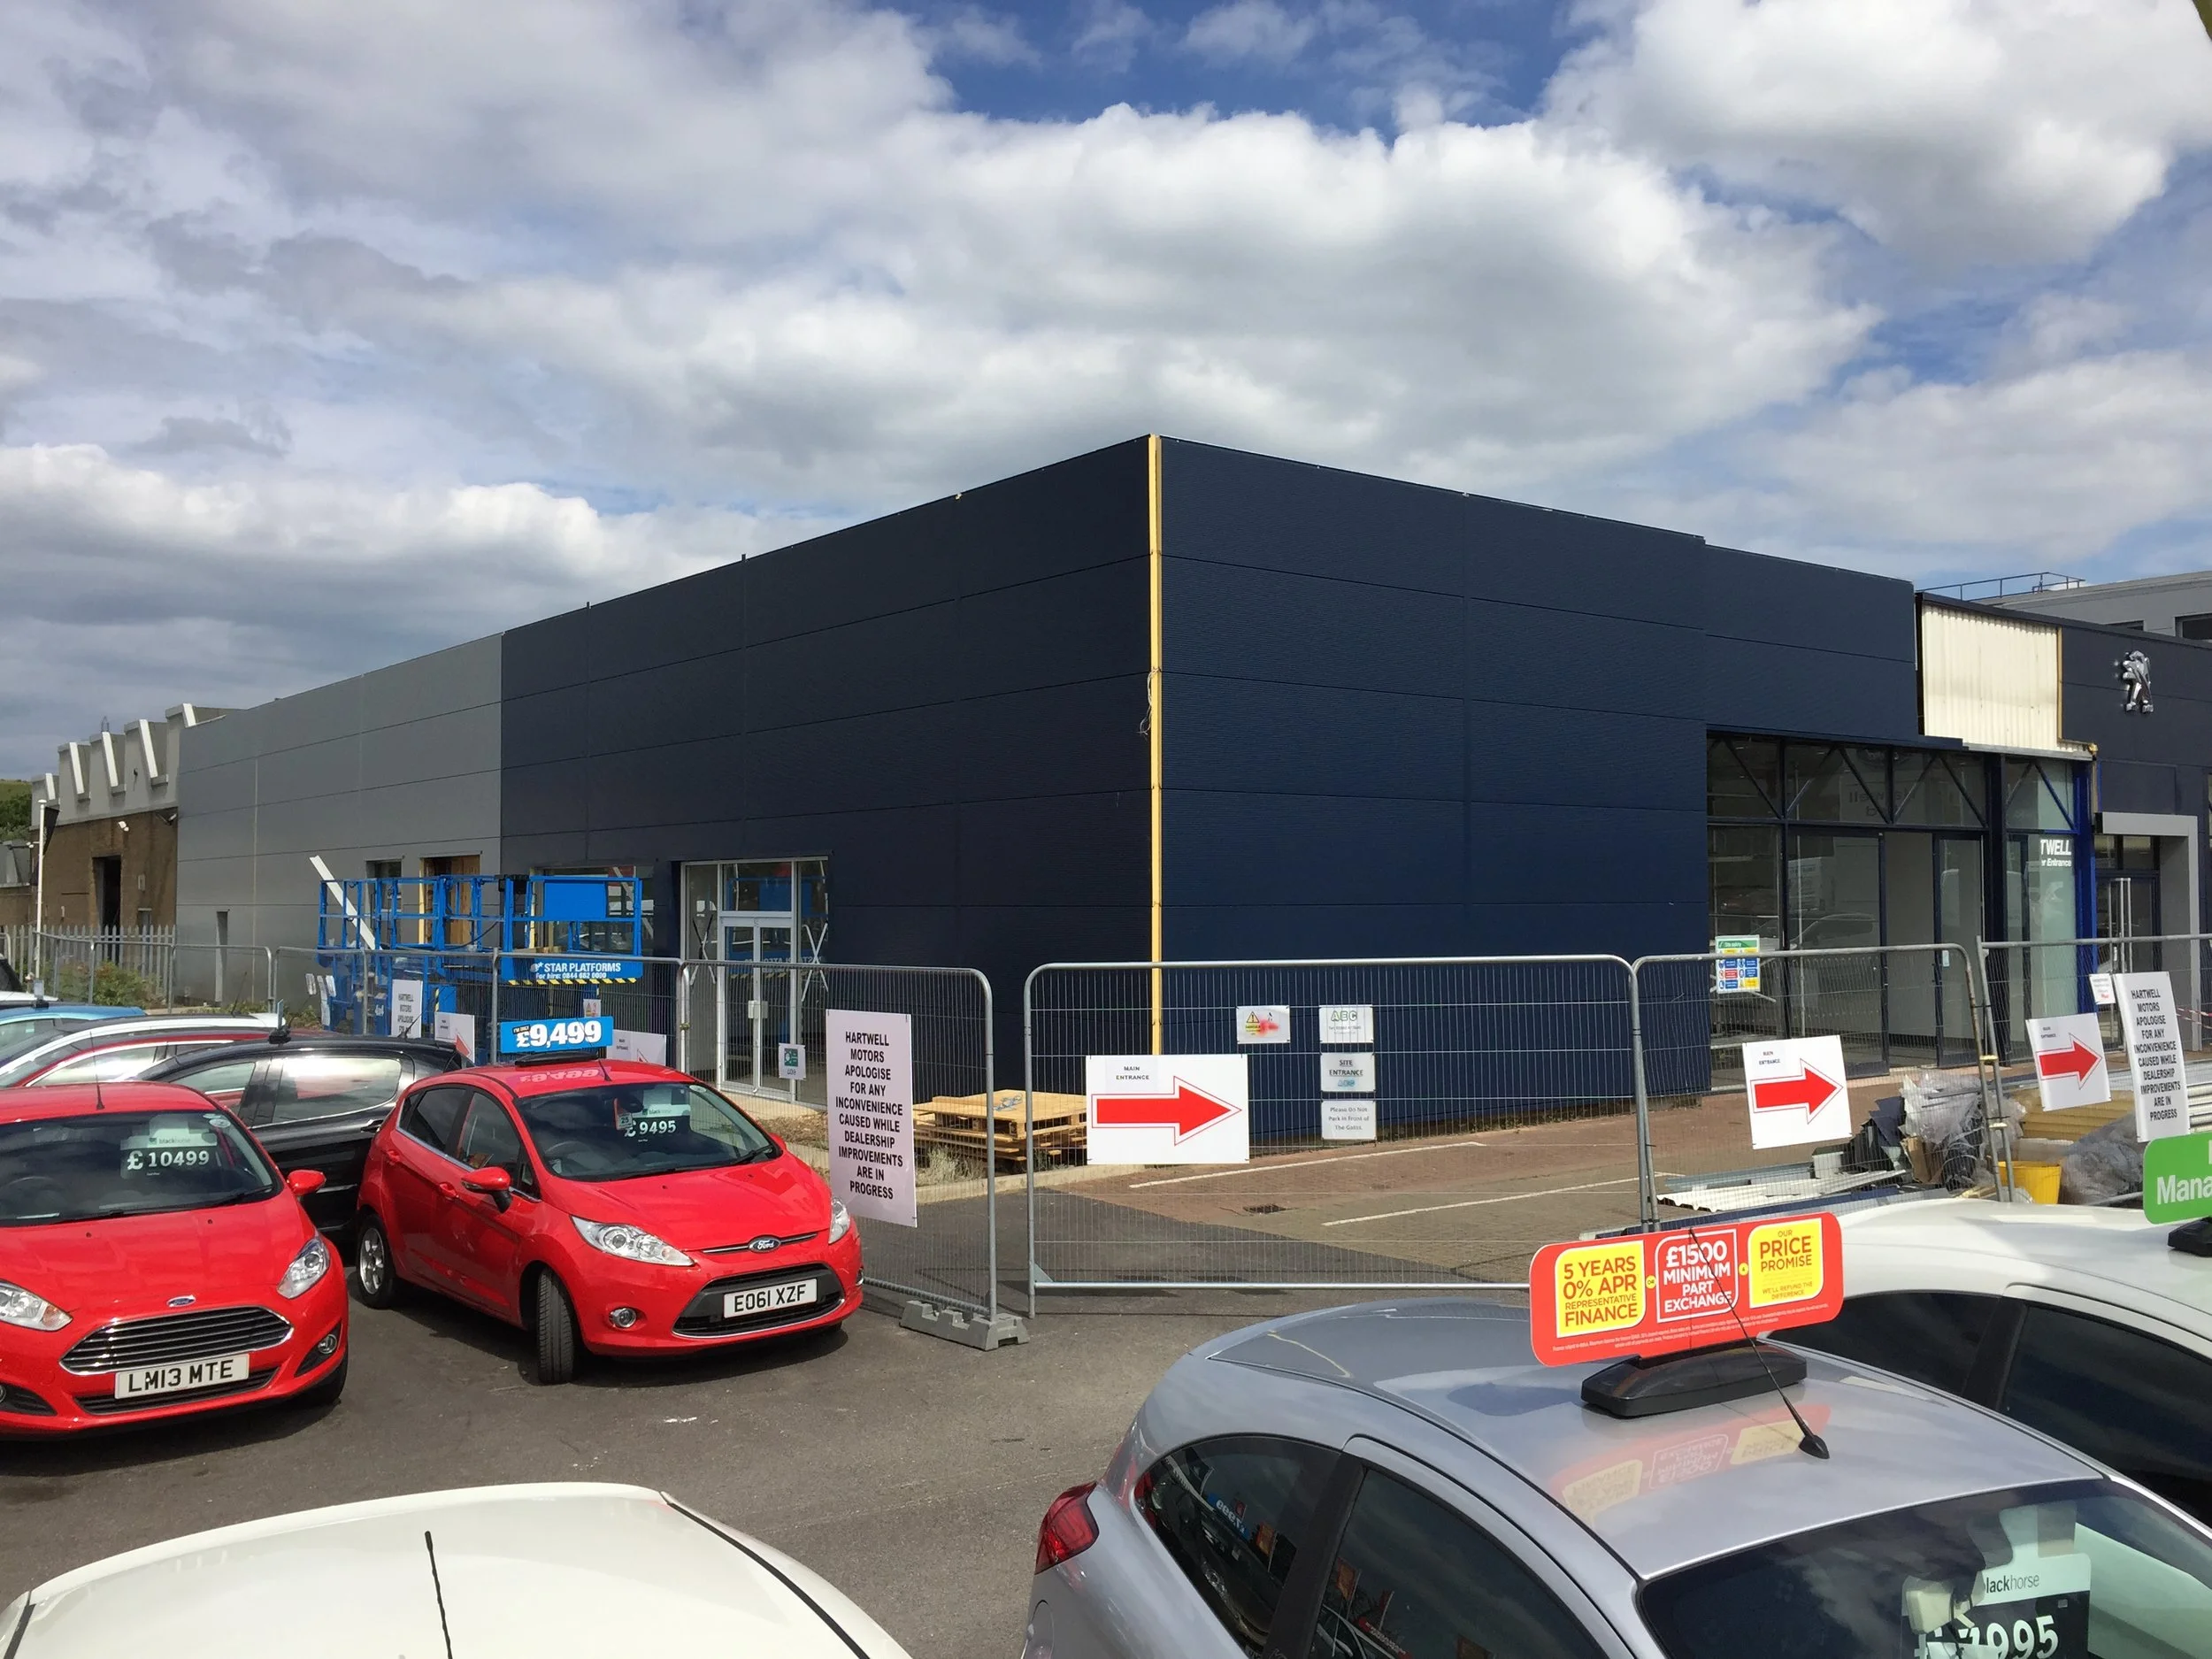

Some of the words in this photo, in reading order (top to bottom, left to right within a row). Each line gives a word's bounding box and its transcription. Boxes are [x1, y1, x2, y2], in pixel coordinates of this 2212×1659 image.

[544, 963, 568, 972] STAR
[569, 963, 621, 972] PLATFORMS
[2131, 988, 2161, 999] HARTWELL
[2137, 1002, 2160, 1012] MOTORS
[2136, 1015, 2166, 1026] APOLOGISE
[516, 1020, 602, 1048] £9,499
[845, 1031, 889, 1046] HARTWELL
[2141, 1030, 2152, 1040] FOR
[2154, 1028, 2165, 1039] ANY
[850, 1048, 885, 1063] MOTORS
[2134, 1041, 2177, 1054] INCONVENIENCE
[2138, 1056, 2159, 1068] CAUSED
[2161, 1055, 2177, 1064] WHILE
[845, 1064, 891, 1080] APOLOGISE
[2143, 1068, 2175, 1080] DEALERSHIP
[850, 1081, 866, 1094] FOR
[869, 1084, 886, 1096] ANY
[2140, 1081, 2180, 1094] IMPROVEMENTS
[835, 1096, 902, 1116] INCONVENIENCE
[2154, 1096, 2165, 1107] ARE
[2166, 1095, 2171, 1105] IN
[839, 1113, 871, 1128] CAUSED
[873, 1118, 900, 1133] WHILE
[2150, 1109, 2177, 1121] PROGRESS
[844, 1131, 895, 1148] DEALERSHIP
[838, 1146, 903, 1167] IMPROVEMENTS
[856, 1165, 873, 1179] ARE
[875, 1168, 885, 1181] IN
[849, 1180, 894, 1200] PROGRESS
[1778, 1229, 1793, 1238] OUR
[757, 1240, 775, 1249] Ford
[1760, 1235, 1812, 1259] PRICE
[1665, 1240, 1728, 1268] £1500
[1563, 1263, 1574, 1279] 5
[1578, 1256, 1636, 1278] YEARS
[1761, 1254, 1812, 1272] PROMISE
[1663, 1262, 1731, 1286] MINIMUM
[1563, 1279, 1593, 1300] 0%
[1598, 1274, 1637, 1295] APR
[1682, 1280, 1714, 1296] PART
[1771, 1289, 1804, 1300] DIFFERENCE
[733, 1290, 771, 1312] EO61
[776, 1284, 806, 1305] XZF
[1565, 1293, 1637, 1310] REPRESENTATIVE
[1664, 1291, 1732, 1313] EXCHANGE
[1565, 1303, 1638, 1327] FINANCE
[128, 1368, 181, 1393] LM13
[188, 1359, 234, 1384] MTE
